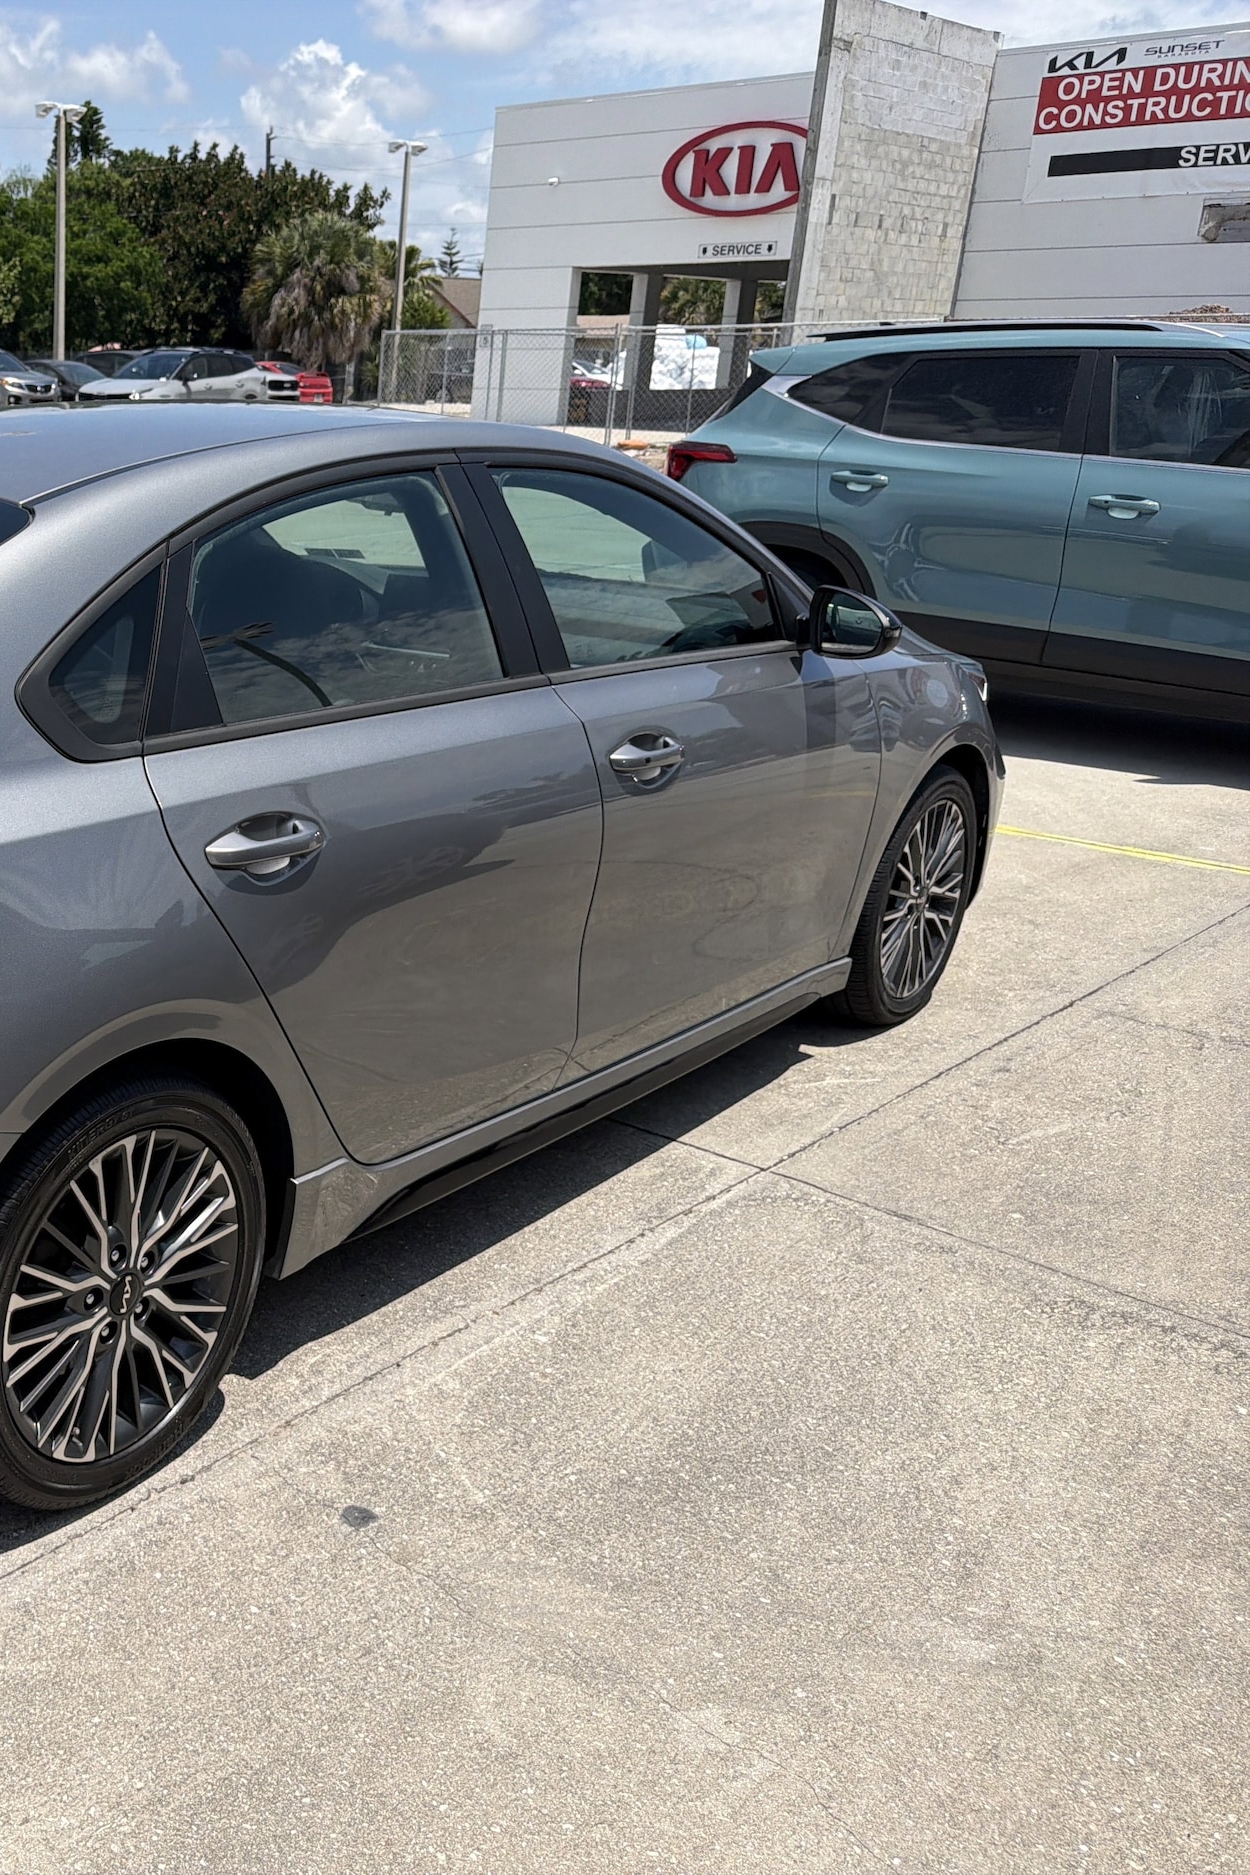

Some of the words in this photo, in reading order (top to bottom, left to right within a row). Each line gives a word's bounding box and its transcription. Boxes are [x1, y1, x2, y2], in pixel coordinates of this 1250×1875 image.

[1048, 47, 1127, 74] KIA
[1057, 70, 1145, 101] OPEN
[1038, 90, 1250, 130] CONSTRUCTI
[690, 142, 800, 198] KIA
[712, 244, 762, 257] SERVICE
[120, 1275, 132, 1314] KIA
